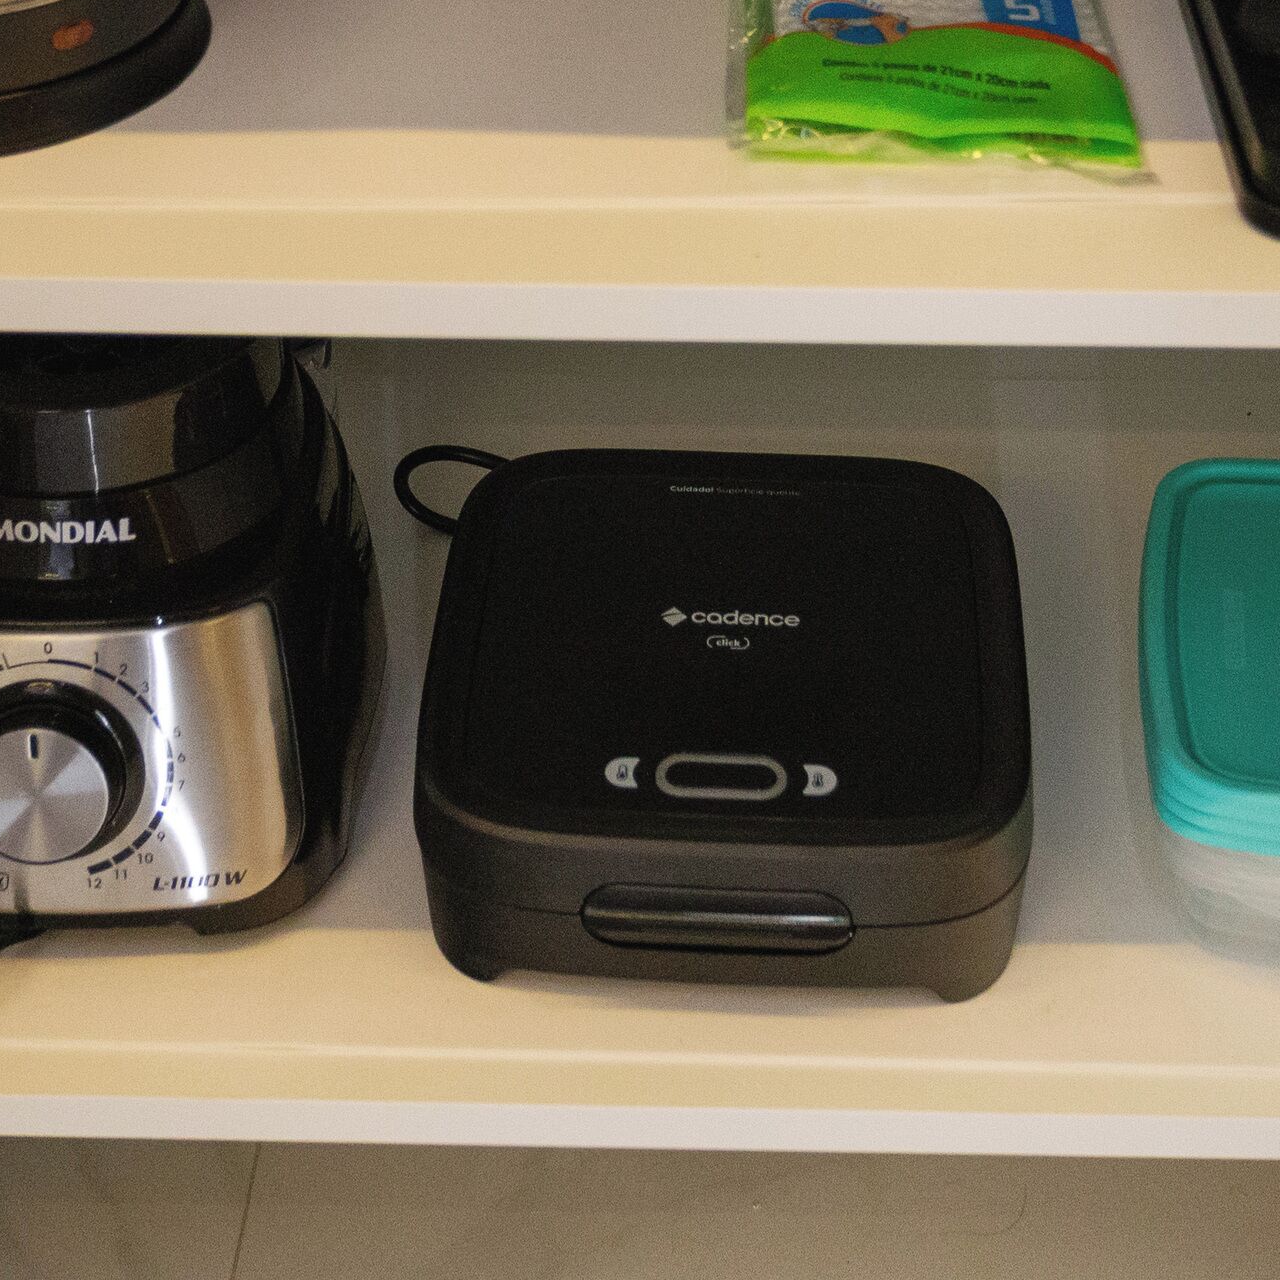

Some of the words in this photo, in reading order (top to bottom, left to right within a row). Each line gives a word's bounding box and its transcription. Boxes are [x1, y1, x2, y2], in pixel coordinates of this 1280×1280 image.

[670, 485, 714, 494] Cuidado!
[691, 610, 800, 628] cadence
[44, 642, 53, 655] 0
[120, 664, 128, 678] 2
[141, 681, 150, 693] 3
[177, 752, 186, 763] 6
[179, 780, 185, 791] 7
[157, 831, 165, 842] 9
[137, 852, 154, 865] 10
[114, 869, 128, 880] 11
[86, 877, 102, 890] 12
